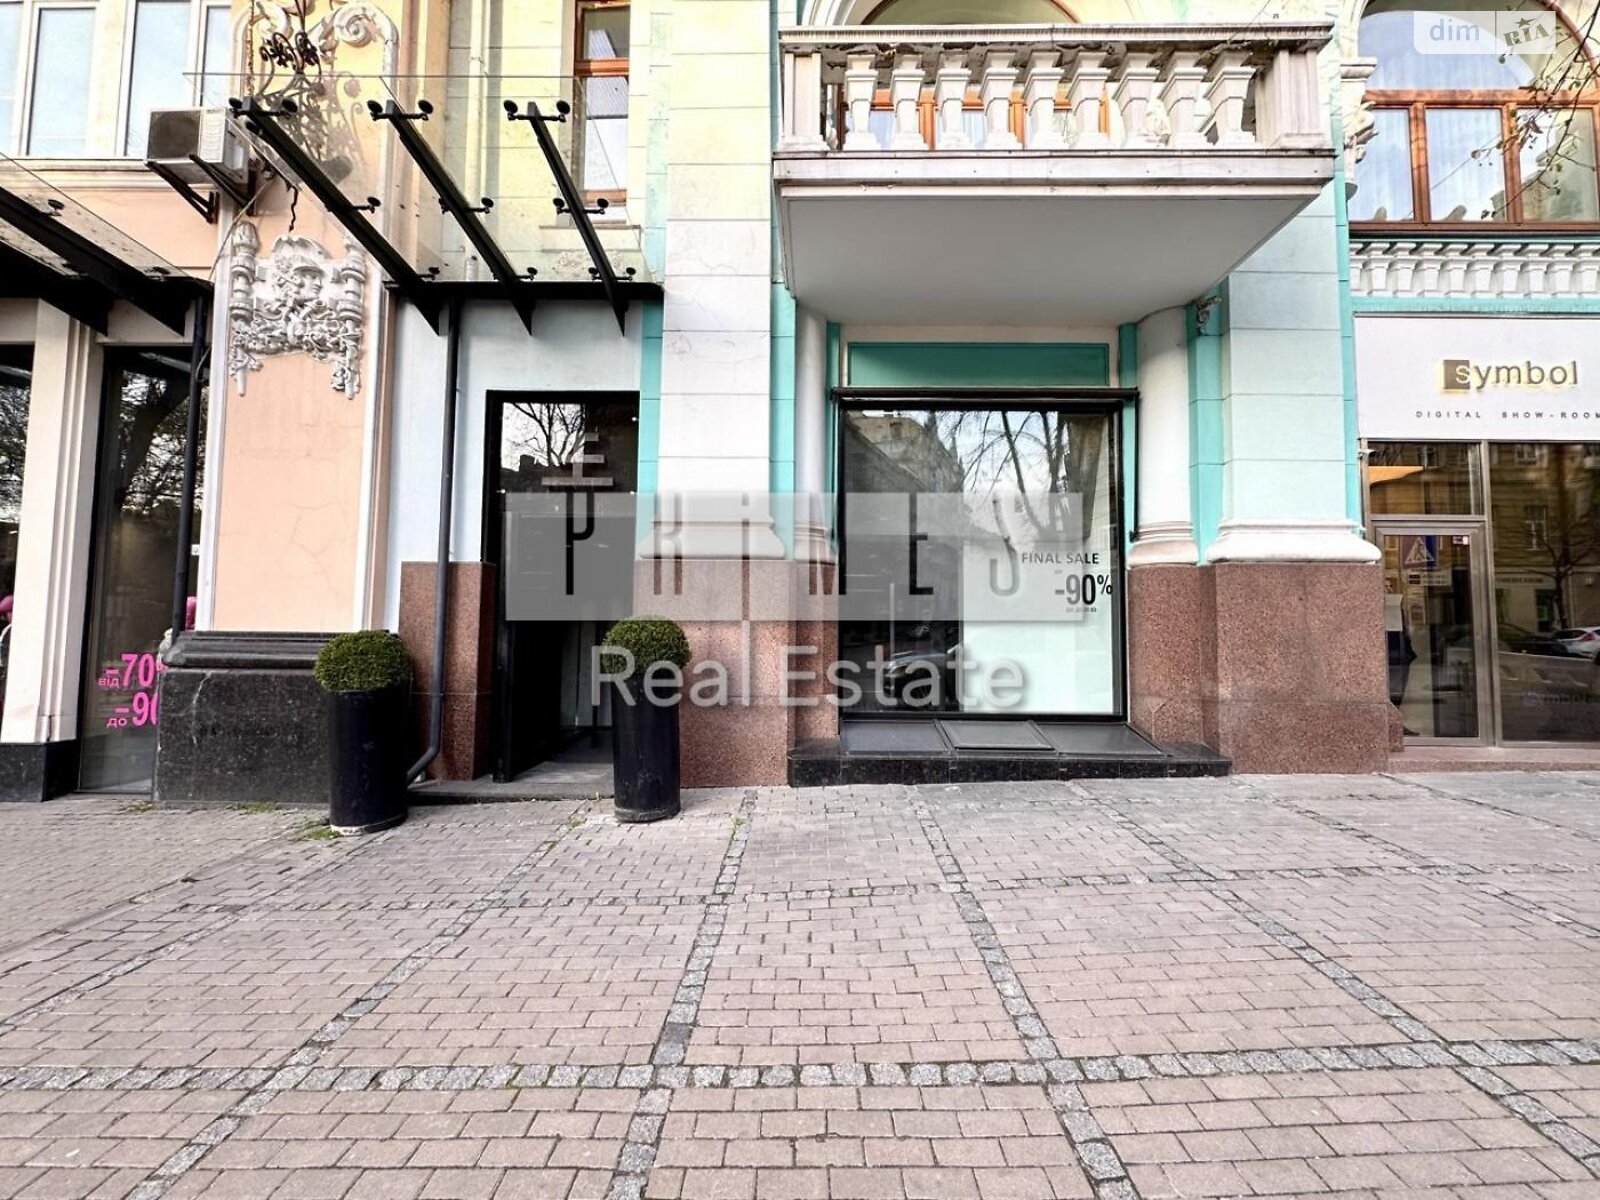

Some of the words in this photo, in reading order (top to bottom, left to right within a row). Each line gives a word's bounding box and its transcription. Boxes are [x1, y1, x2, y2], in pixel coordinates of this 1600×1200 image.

[1443, 360, 1578, 390] symbol
[1416, 411, 1480, 419] DIGITAL
[1022, 552, 1062, 564] FINAL
[1066, 552, 1099, 564] SALE
[1055, 574, 1113, 605] -90%
